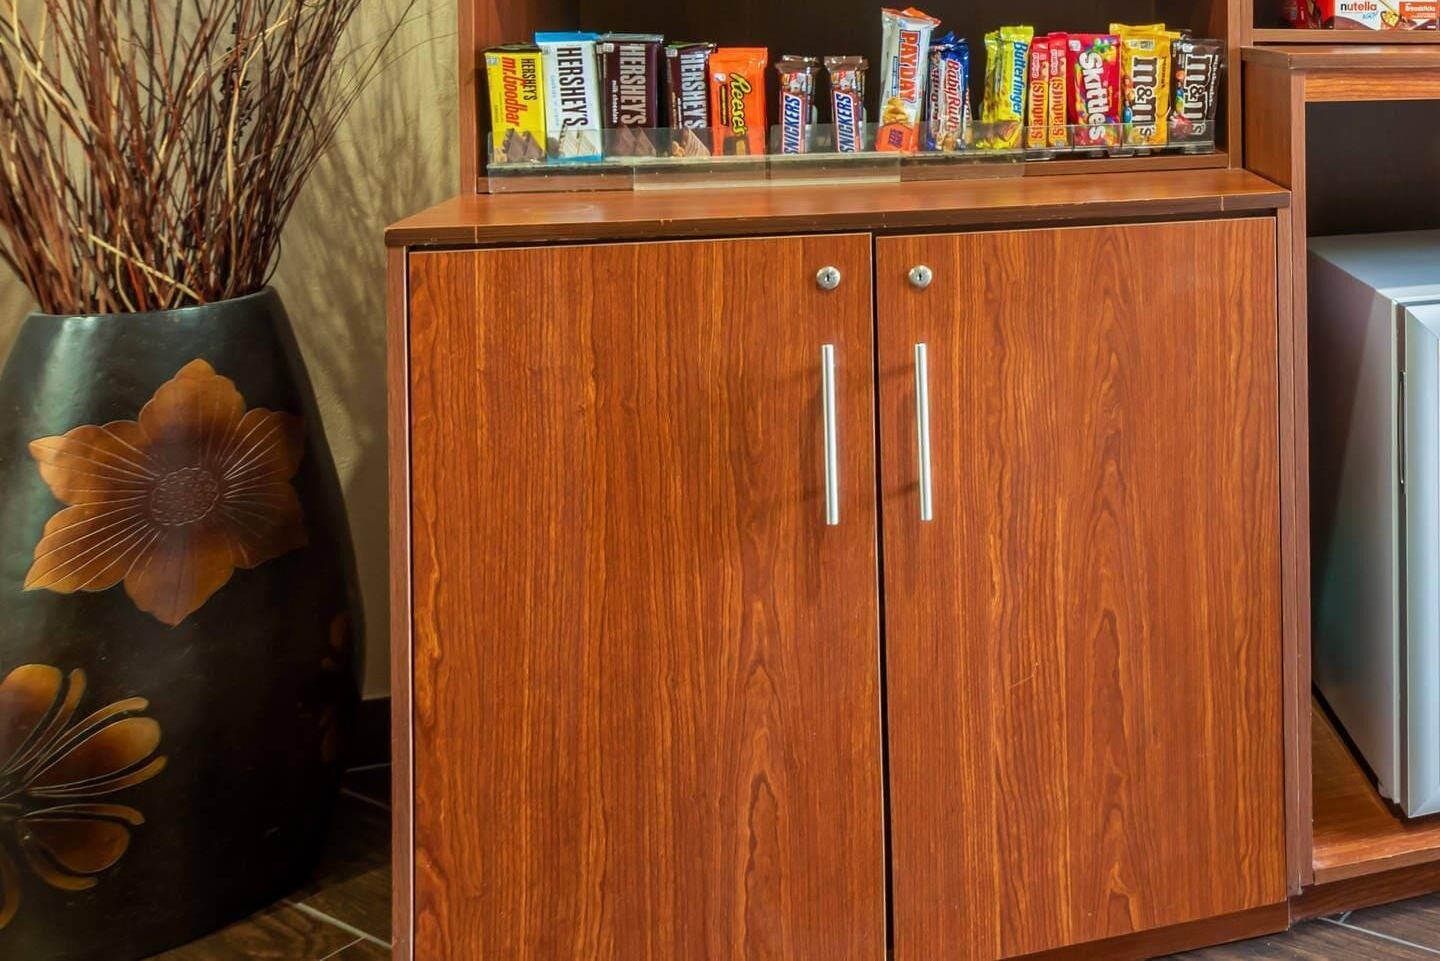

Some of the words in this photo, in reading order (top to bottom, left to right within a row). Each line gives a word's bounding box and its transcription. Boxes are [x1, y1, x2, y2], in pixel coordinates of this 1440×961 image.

[1340, 1, 1378, 12] nutella
[1404, 5, 1436, 13] Breadsticks
[521, 58, 538, 101] HERSHEY'S
[556, 47, 589, 126] HERSHEY'S
[619, 43, 647, 125] HERSHEY'S
[680, 52, 707, 130] HERSHEY'S
[900, 30, 920, 103] PAYDAY
[1010, 41, 1028, 115] Butterfinger
[1079, 52, 1110, 140] Skittles
[1132, 55, 1158, 137] m&m's
[1184, 54, 1213, 135] m&m's
[784, 95, 800, 153] SNICKERS
[836, 93, 855, 152] SNICKERS
[1031, 80, 1045, 139] Starburst
[1052, 78, 1065, 136] Starburst
